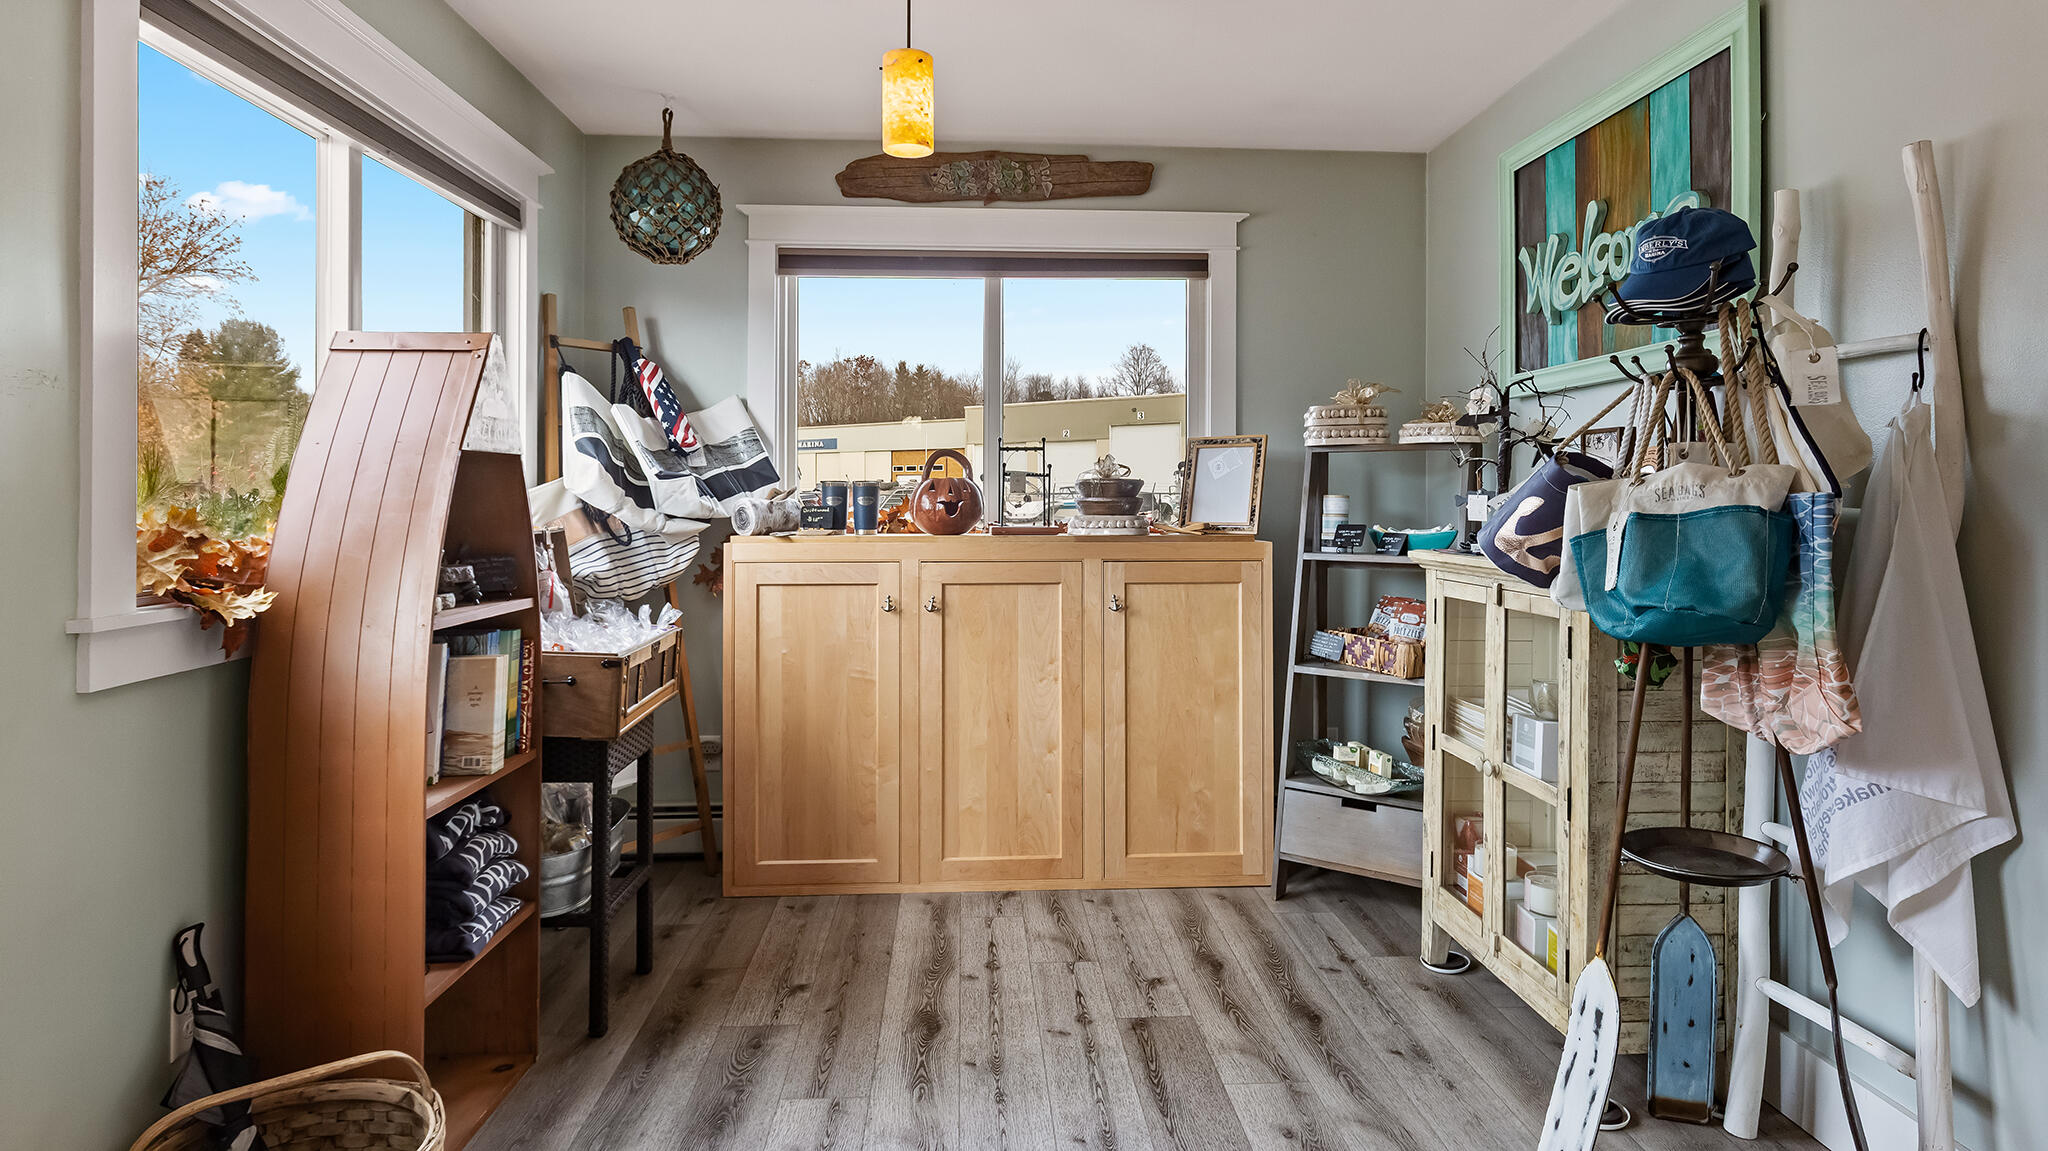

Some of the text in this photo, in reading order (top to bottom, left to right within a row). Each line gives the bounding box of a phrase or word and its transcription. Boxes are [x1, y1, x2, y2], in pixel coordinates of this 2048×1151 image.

[1138, 411, 1144, 419] 3
[1654, 484, 1706, 502] SEA BAGS
